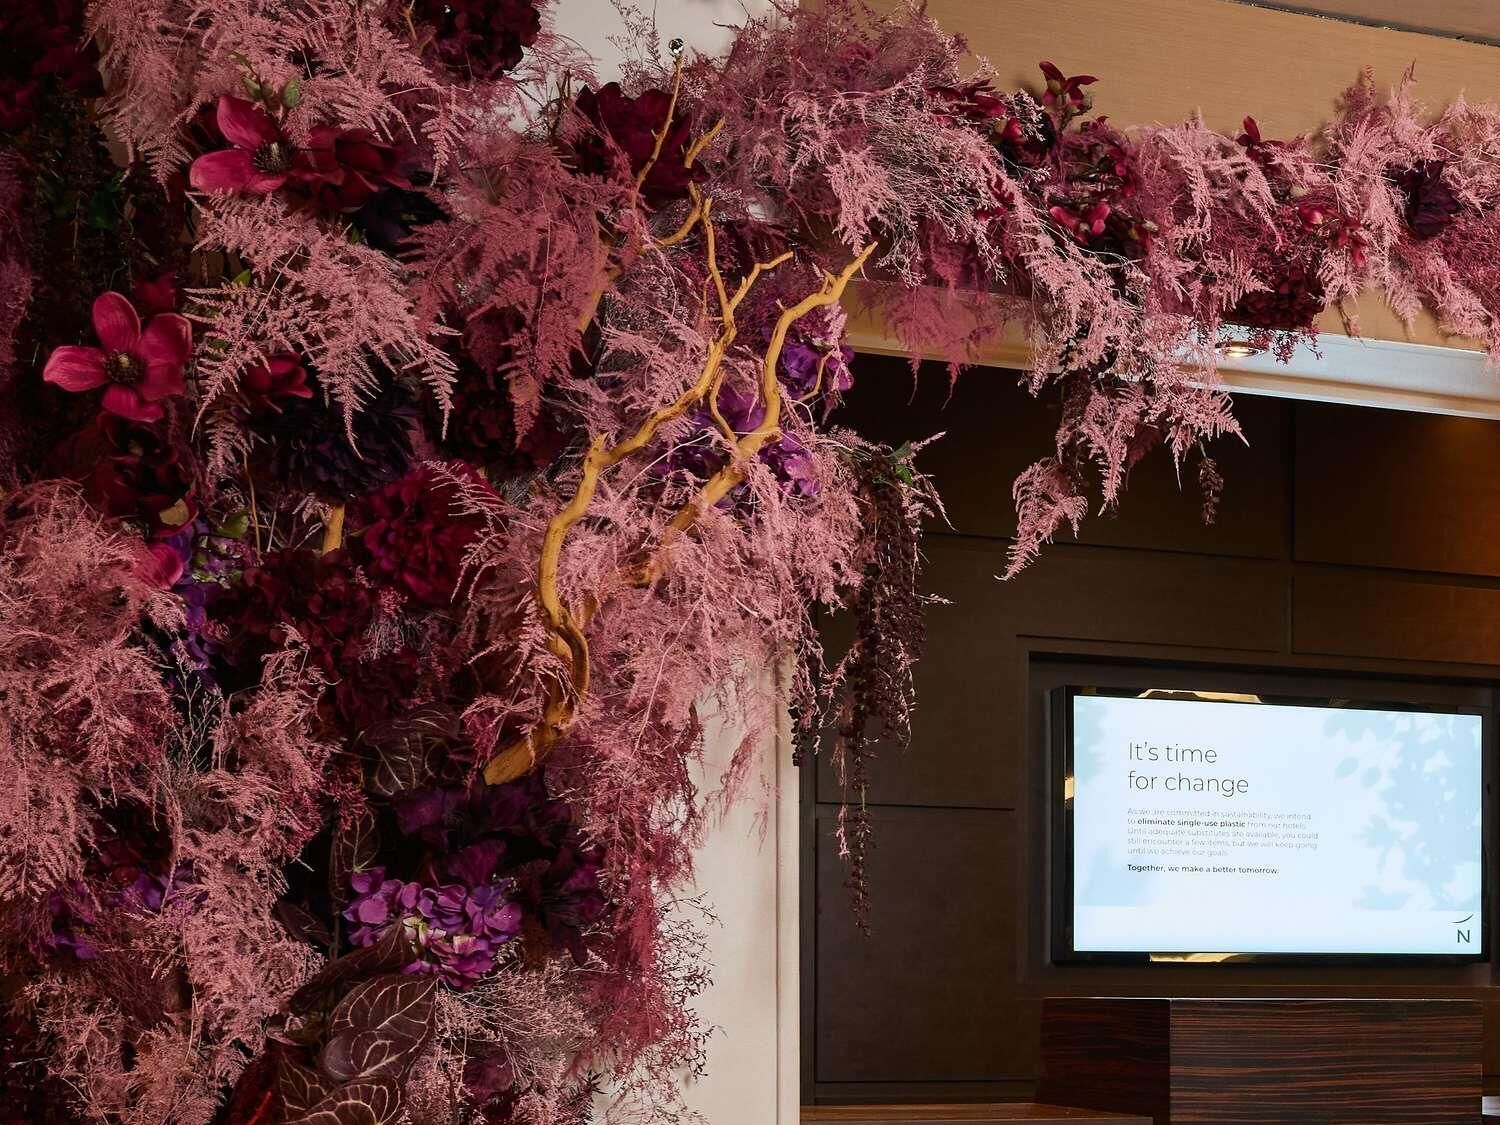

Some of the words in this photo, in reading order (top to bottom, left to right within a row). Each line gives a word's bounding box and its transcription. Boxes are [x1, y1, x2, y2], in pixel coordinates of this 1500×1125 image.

[1129, 741, 1159, 761] It's
[1166, 743, 1217, 763] time
[1128, 770, 1158, 790] for
[1165, 772, 1249, 797] change
[1137, 817, 1175, 826] eliminate
[1177, 818, 1218, 828] single-use
[1219, 820, 1246, 829] plastic
[1127, 863, 1166, 873] Together,
[1167, 865, 1180, 873] we
[1181, 864, 1204, 873] make
[1212, 865, 1237, 874] better
